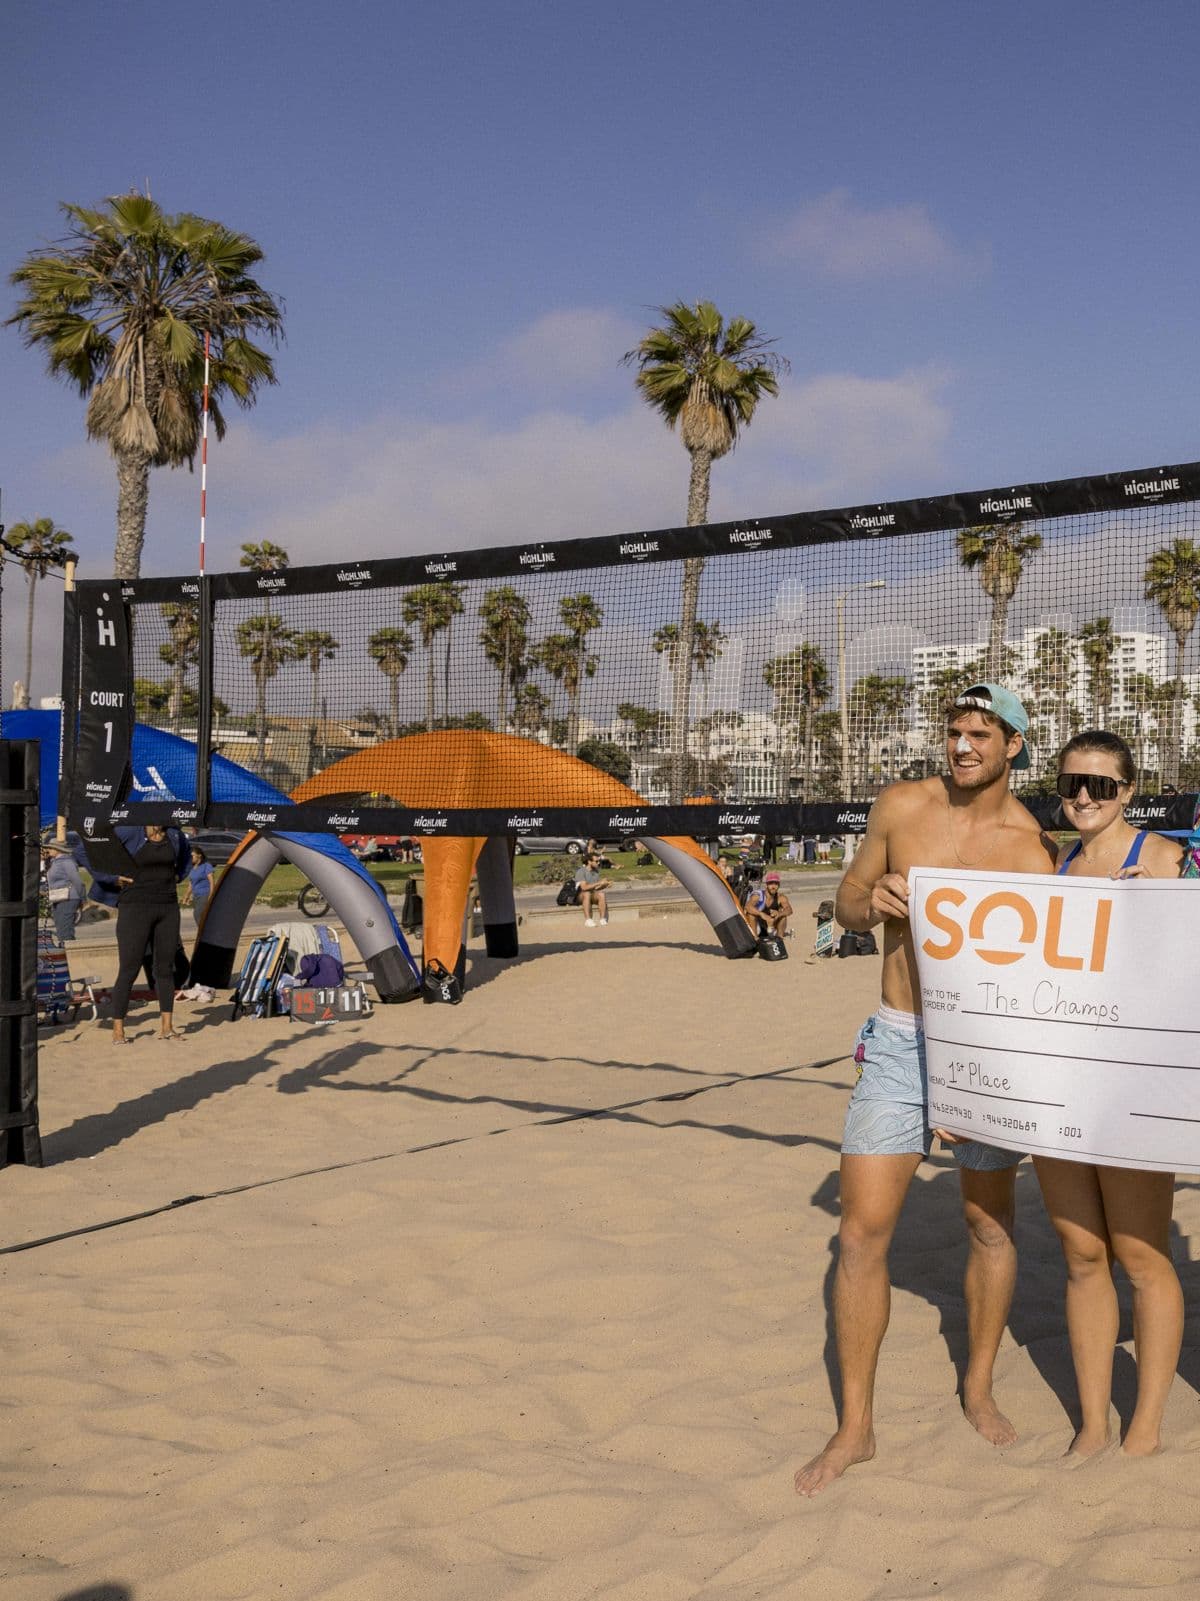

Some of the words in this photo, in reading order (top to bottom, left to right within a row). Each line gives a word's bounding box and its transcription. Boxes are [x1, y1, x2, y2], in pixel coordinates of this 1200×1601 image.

[91, 691, 125, 707] COURT
[104, 721, 113, 753] 1
[922, 887, 1113, 973] SOLI
[295, 991, 315, 1015] 15
[341, 990, 361, 1012] 11
[923, 987, 933, 997] PAY
[935, 990, 944, 999] TO
[946, 991, 961, 1001] THE
[923, 1000, 945, 1011] ORDER
[946, 1003, 957, 1012] OF
[977, 982, 1019, 1013] The
[1033, 980, 1119, 1031] Champs
[948, 1061, 965, 1083] 1st
[968, 1062, 1011, 1091] Place
